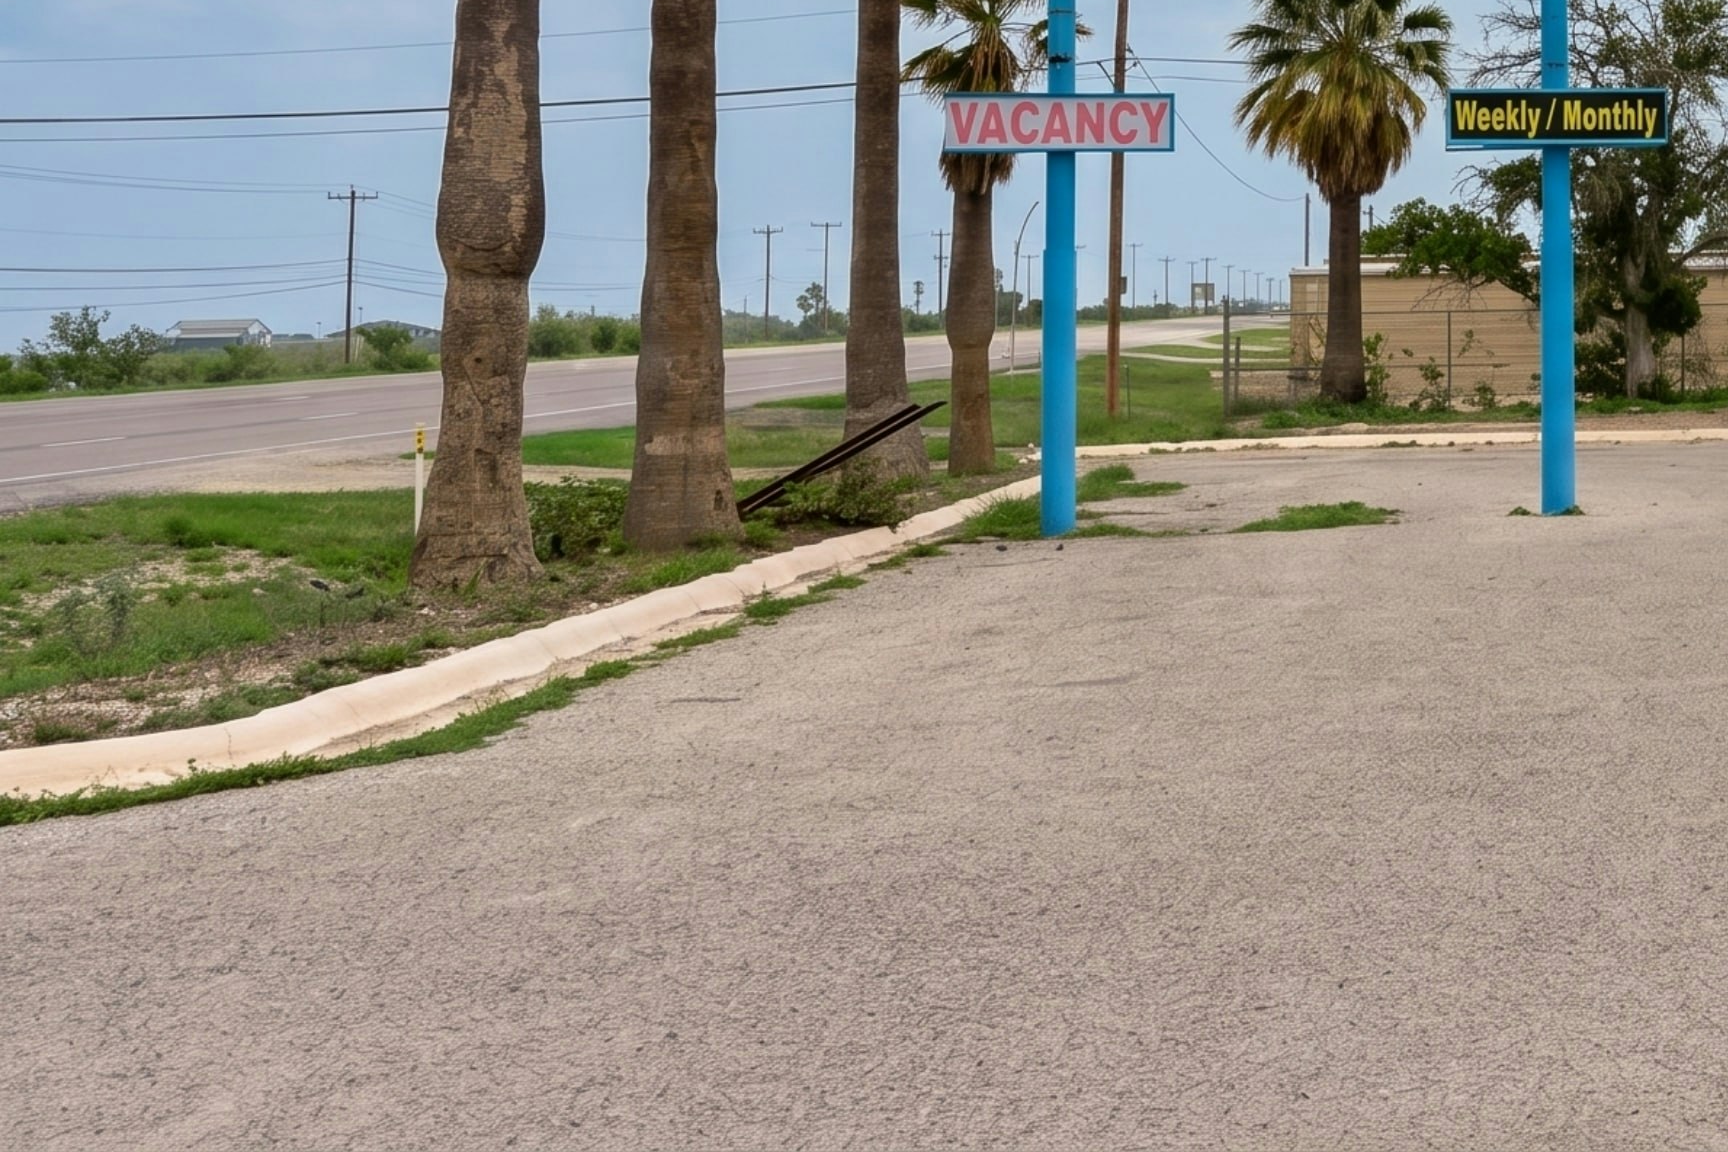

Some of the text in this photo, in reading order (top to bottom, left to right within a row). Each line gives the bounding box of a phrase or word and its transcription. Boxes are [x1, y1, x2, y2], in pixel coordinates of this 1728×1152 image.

[950, 101, 1168, 145] VACANCY
[1455, 99, 1541, 139] Weekly
[1563, 99, 1657, 139] Monthly
